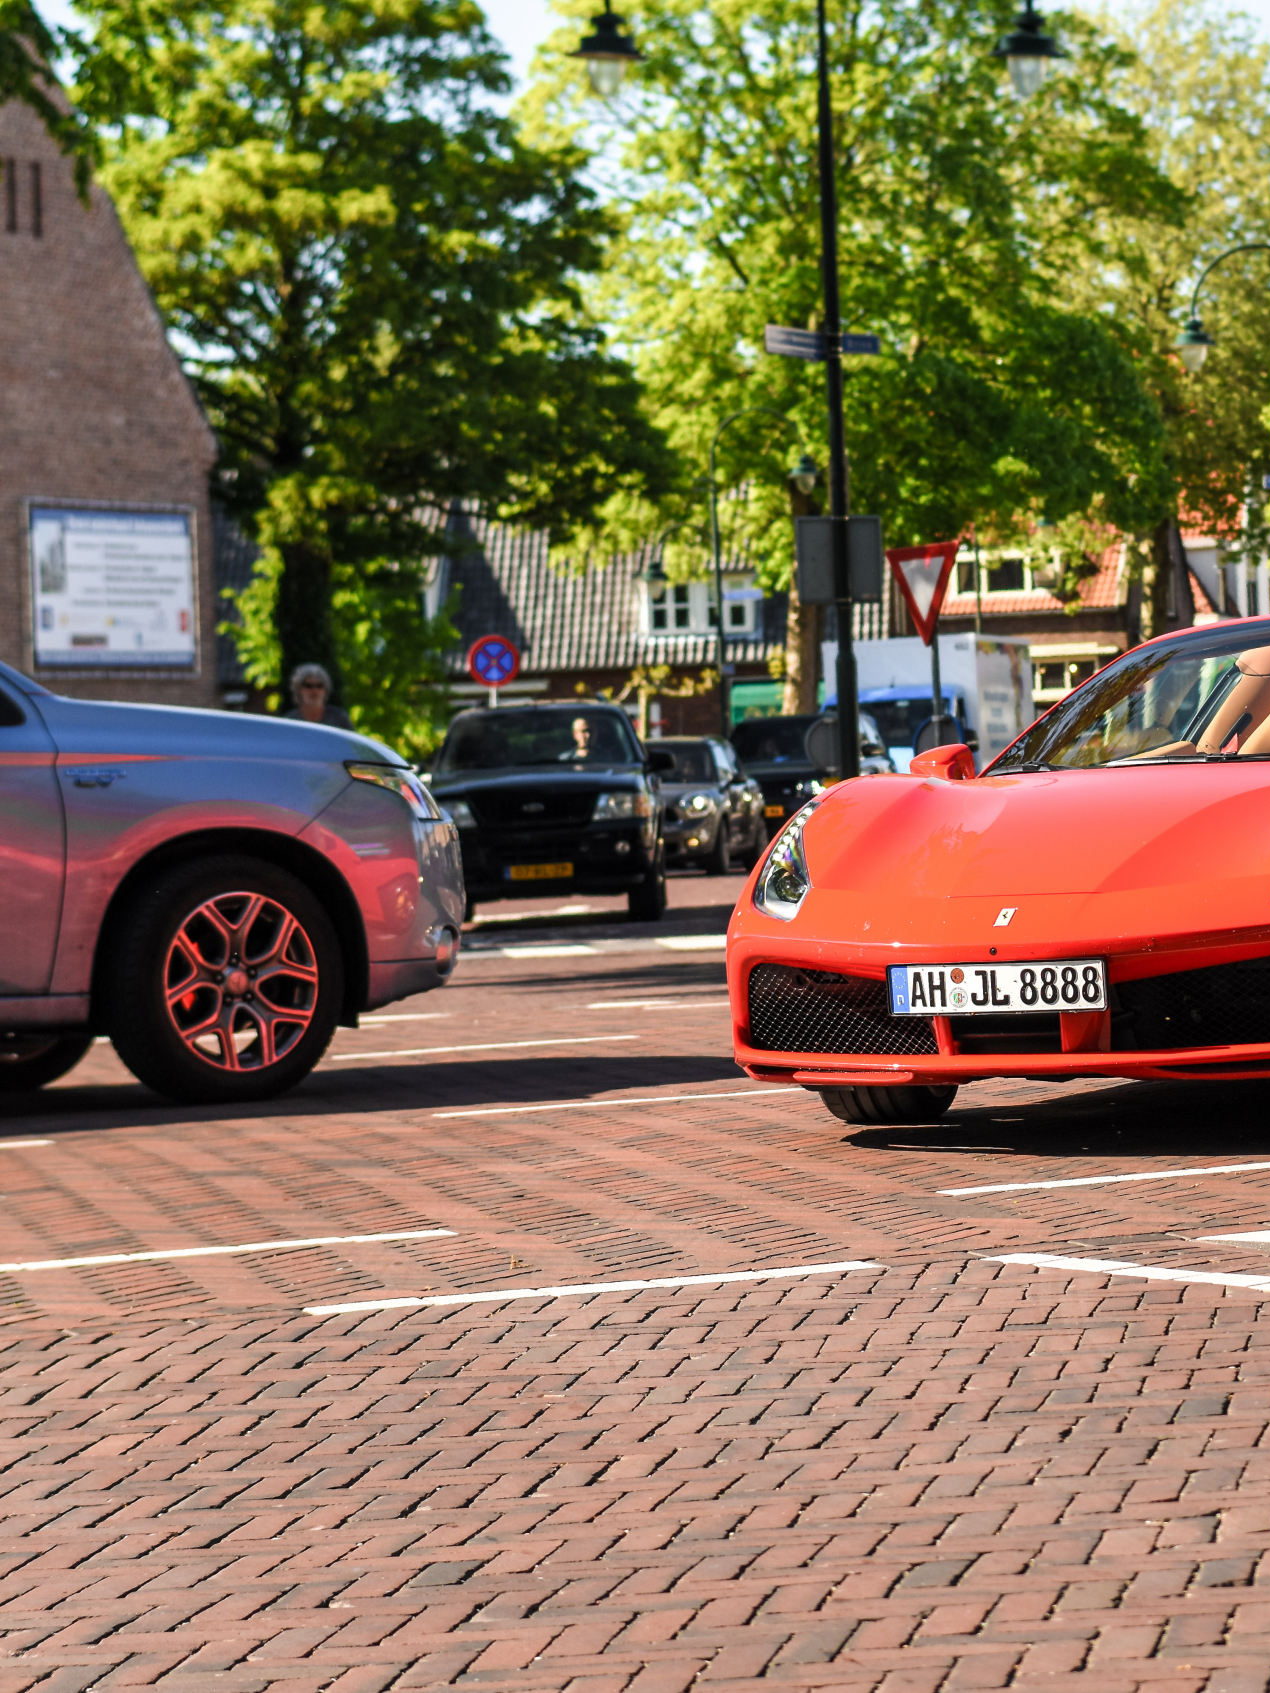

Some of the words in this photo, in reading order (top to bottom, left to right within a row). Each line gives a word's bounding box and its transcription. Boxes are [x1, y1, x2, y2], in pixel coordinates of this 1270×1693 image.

[911, 971, 948, 1007] AH
[971, 970, 1011, 1006] JL
[1020, 966, 1101, 1006] 8888
